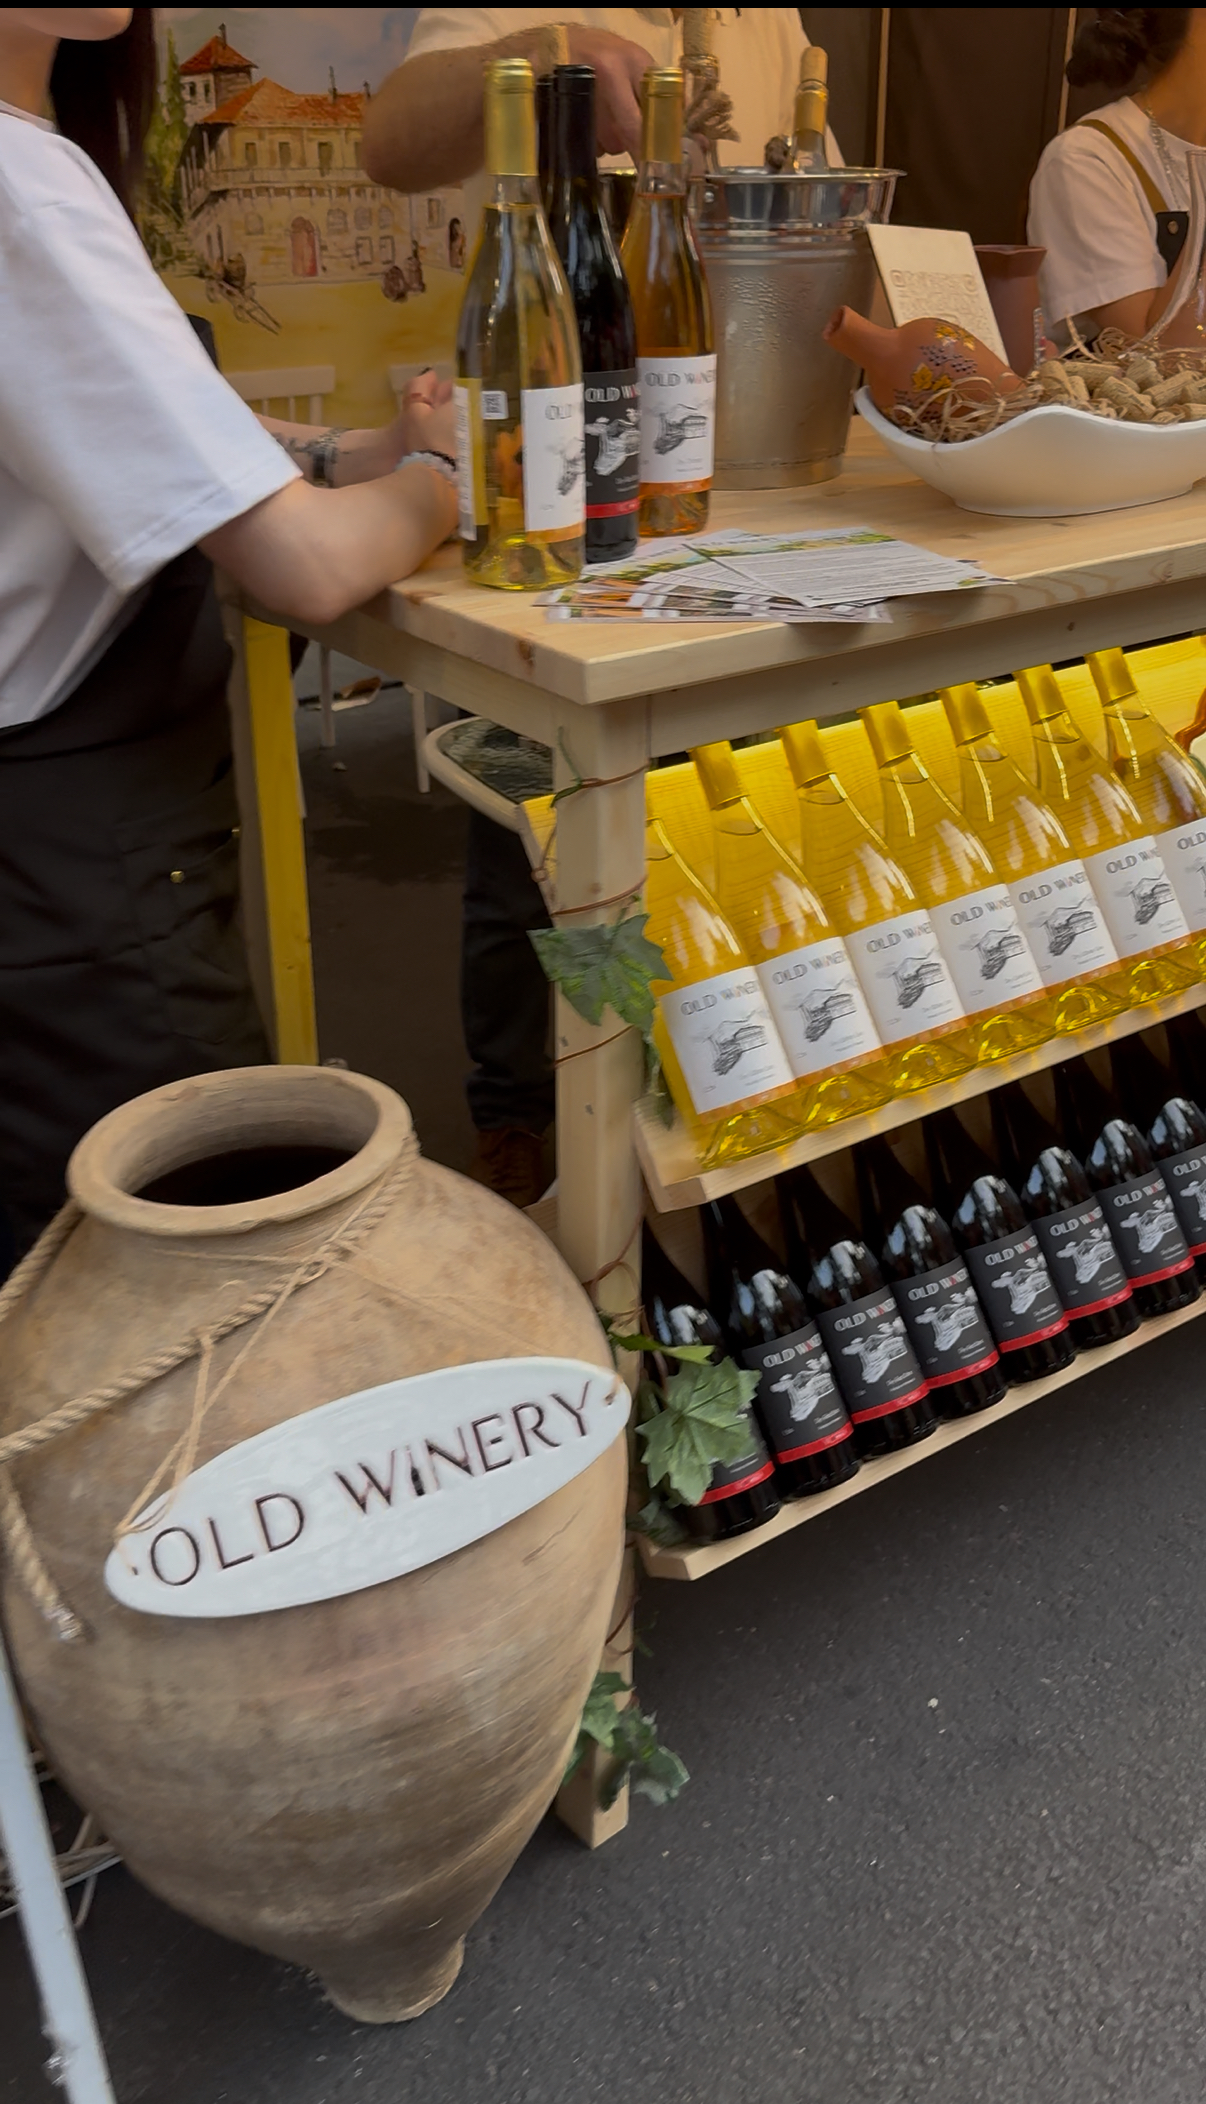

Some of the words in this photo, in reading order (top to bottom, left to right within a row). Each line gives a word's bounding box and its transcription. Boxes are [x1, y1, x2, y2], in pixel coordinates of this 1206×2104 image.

[645, 372, 681, 387] OLD
[585, 387, 620, 402] OLD
[1106, 855, 1137, 874] OLD
[1018, 884, 1053, 904] OLD
[950, 906, 984, 926] OLD
[866, 933, 902, 953] OLD
[772, 964, 808, 985] OLD
[681, 994, 717, 1016] OLD
[1173, 1159, 1201, 1177] OLD
[1113, 1189, 1143, 1207] OLD
[1050, 1219, 1079, 1237] OLD
[985, 1248, 1015, 1266] OLD
[908, 1281, 938, 1301] OLD
[834, 1312, 867, 1332] OLD
[762, 1347, 796, 1368] OLD
[150, 1491, 305, 1586] OLD
[334, 1380, 592, 1514] WINERY
